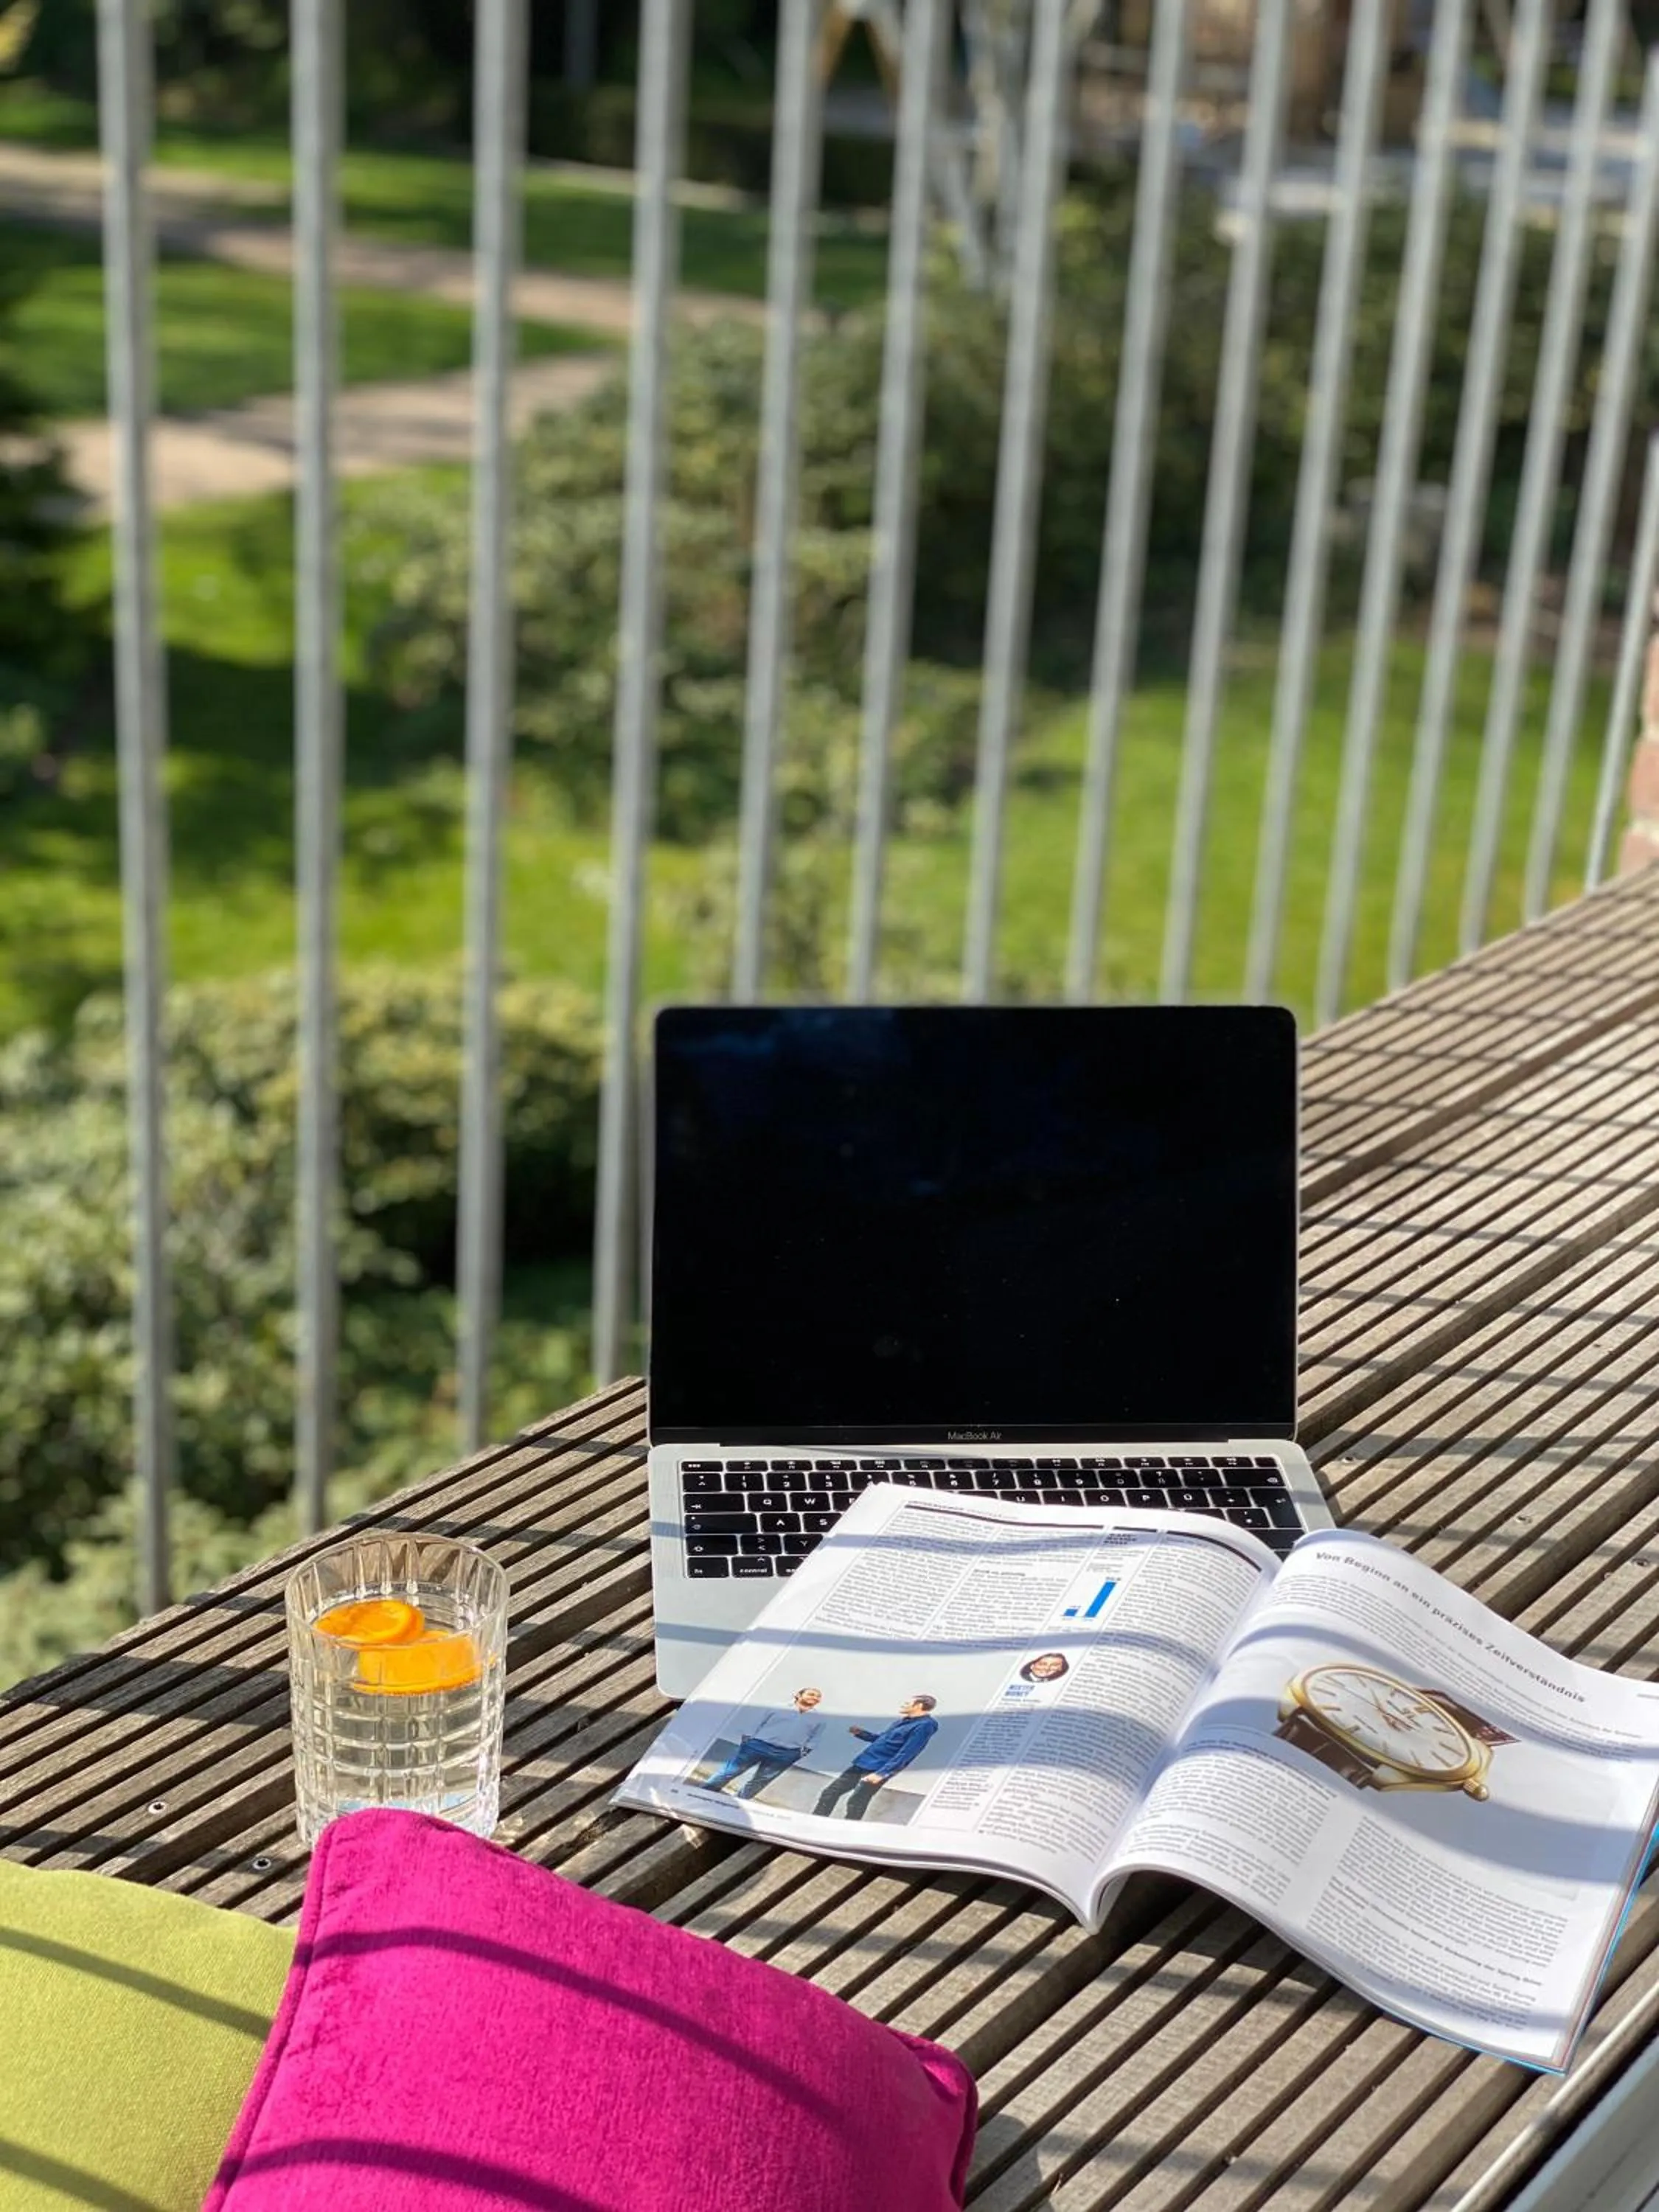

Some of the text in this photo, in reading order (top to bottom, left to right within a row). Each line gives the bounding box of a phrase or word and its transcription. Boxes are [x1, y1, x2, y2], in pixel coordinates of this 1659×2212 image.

[947, 1431, 1002, 1440] MacBook Air
[1315, 1551, 1340, 1562] Von
[1393, 1580, 1410, 1593] an
[1411, 1591, 1432, 1608] ein
